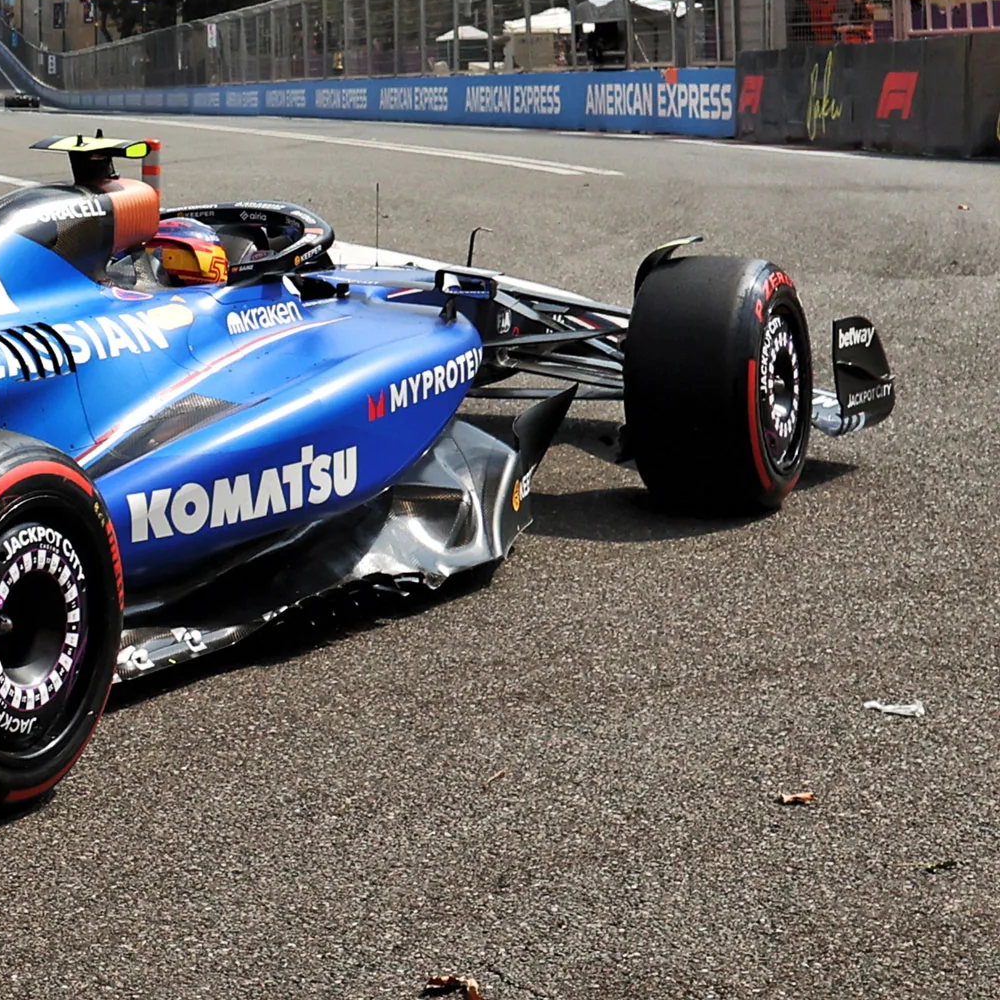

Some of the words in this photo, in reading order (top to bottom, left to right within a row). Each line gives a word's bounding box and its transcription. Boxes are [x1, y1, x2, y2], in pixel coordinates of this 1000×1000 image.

[379, 87, 413, 110] AMERICAN
[414, 87, 448, 112] EXPRESS
[464, 85, 512, 113] AMERICAN
[513, 85, 561, 115] EXPRESS
[585, 83, 653, 116] AMERICAN
[657, 83, 733, 121] EXPRESS
[838, 326, 875, 349] betway
[847, 388, 876, 408] JACKPOT
[126, 445, 358, 543] KOMATSU
[2, 526, 62, 563] JACKPOT
[62, 538, 85, 581] CITY
